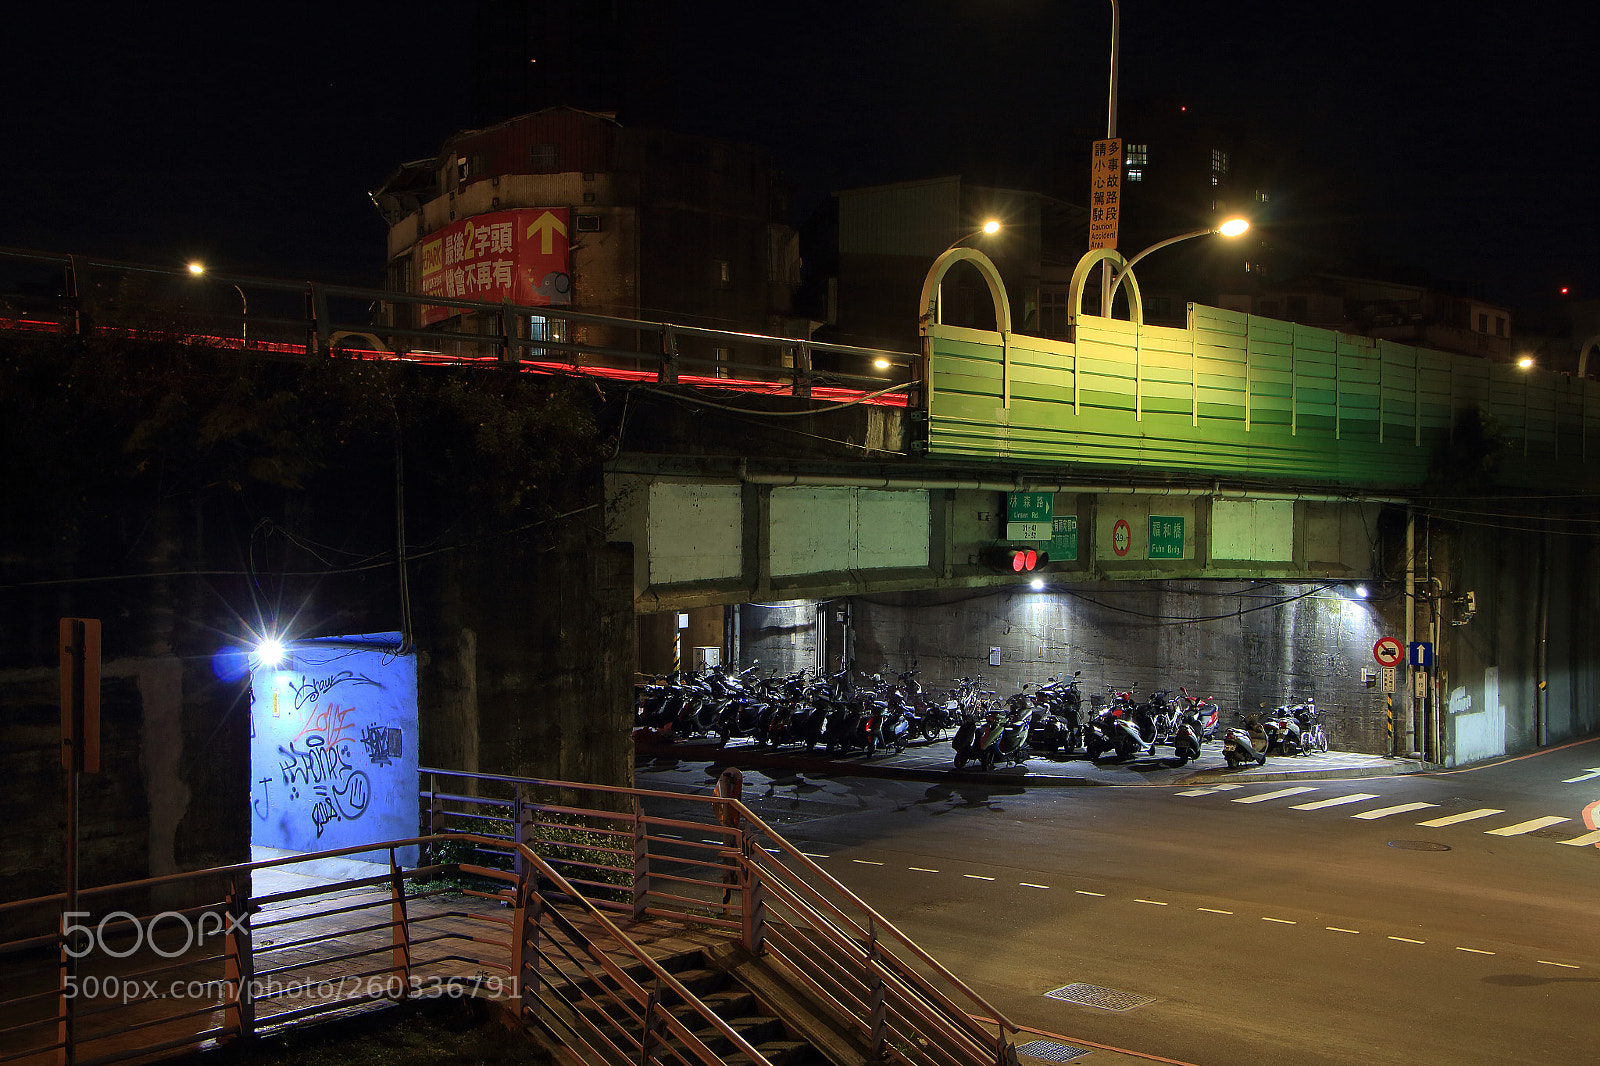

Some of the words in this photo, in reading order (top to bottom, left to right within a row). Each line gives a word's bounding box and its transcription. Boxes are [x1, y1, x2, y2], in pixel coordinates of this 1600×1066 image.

[1092, 142, 1107, 222] 請小心駕駛
[1106, 141, 1119, 221] 多事故路段
[445, 221, 513, 265] 最後2字頭
[1091, 230, 1116, 240] Accident
[1091, 241, 1104, 249] Area
[445, 258, 514, 298] 機會不再有
[1010, 494, 1044, 509] 林森路
[1152, 521, 1182, 539] 福和橋
